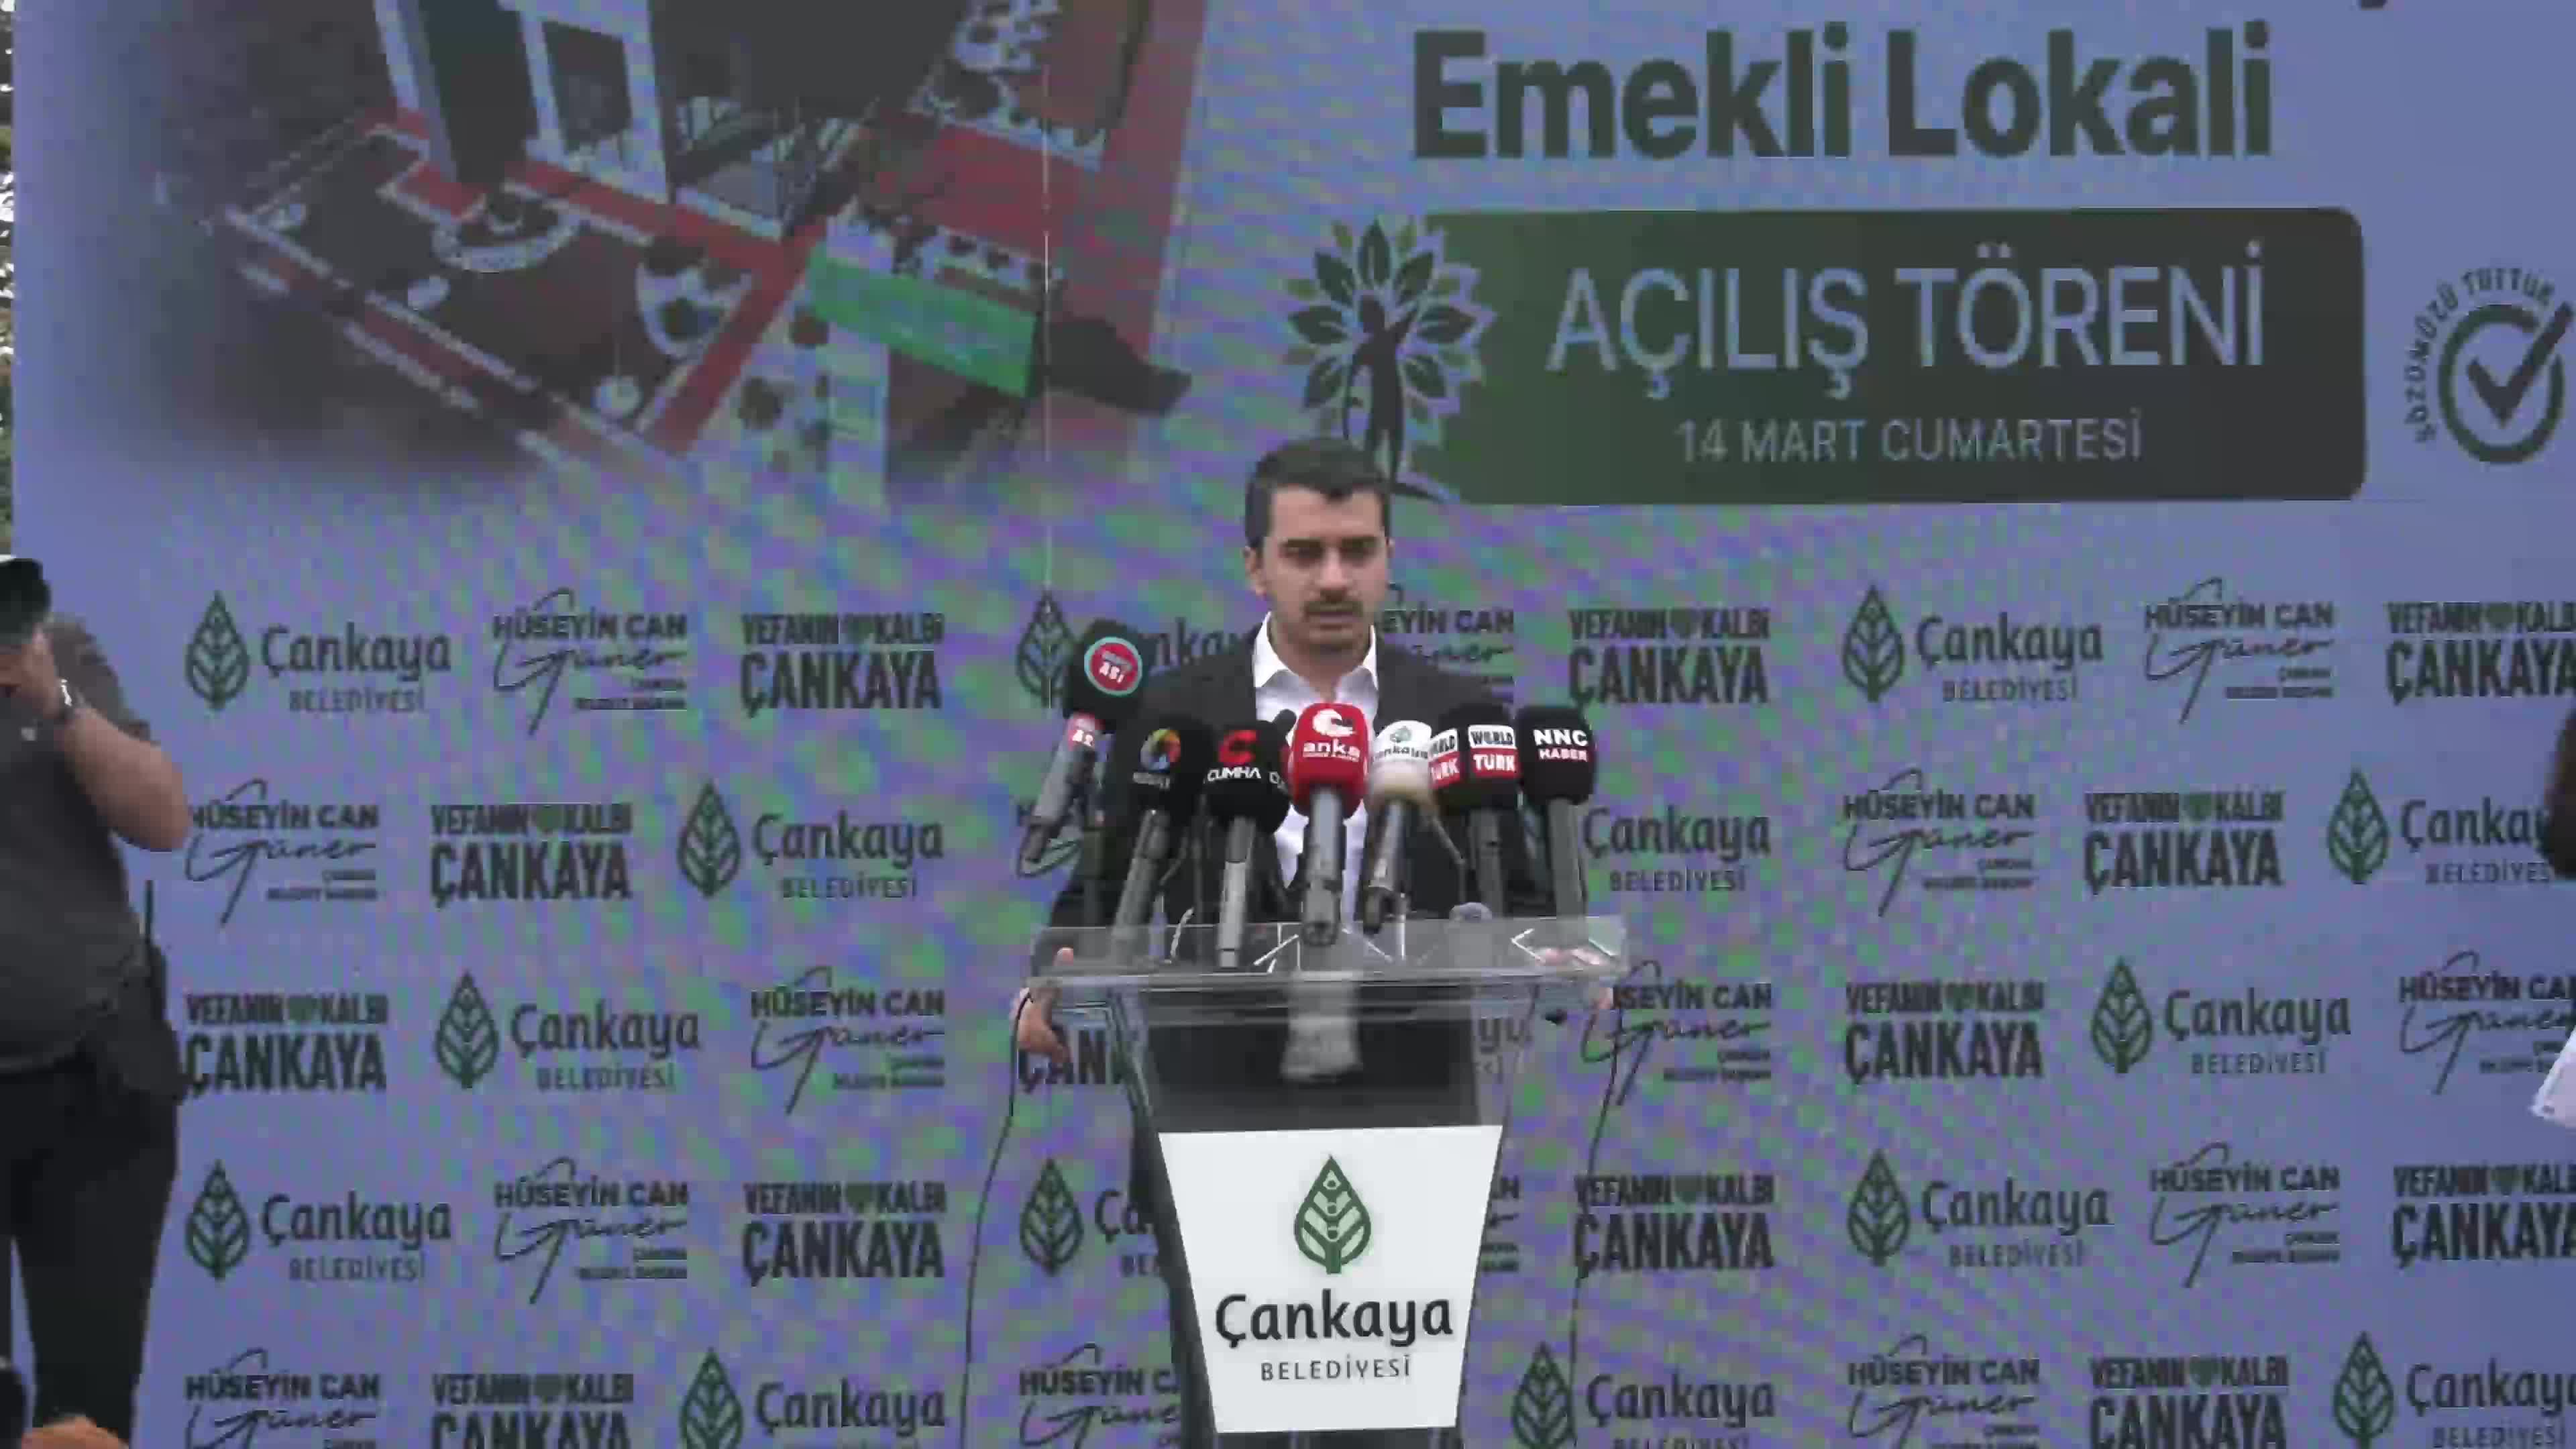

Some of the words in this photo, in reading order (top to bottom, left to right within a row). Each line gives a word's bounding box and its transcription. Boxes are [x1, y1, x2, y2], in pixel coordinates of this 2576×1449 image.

[1415, 21, 1850, 159] Emekli
[1887, 19, 2271, 159] Lokali
[1544, 267, 1869, 399] AÇILIŞ
[1894, 239, 2264, 368] TÖRENİ
[1677, 419, 1728, 463] 14
[1741, 419, 1866, 462] MART
[1882, 407, 2141, 462] CUMARTESİ
[493, 607, 617, 639] HÜSEYİN
[625, 614, 686, 639] CAN
[1382, 602, 1448, 634] EYİN
[1454, 609, 1514, 634] CAN
[1916, 612, 2102, 671] Çankaya
[2146, 597, 2265, 629] HÜSEYİN
[2275, 602, 2332, 629] CAN
[2517, 602, 2576, 634] KALB
[262, 622, 451, 682] Çankaya
[1568, 646, 1768, 708] ÇANKAYA
[741, 651, 943, 718] ÇANKAYA
[1303, 739, 1360, 759] anka
[1533, 729, 1588, 747] NNC
[1540, 747, 1587, 762] HABER
[319, 807, 378, 829] CAN
[1584, 804, 1771, 862] Çankaya
[1844, 789, 1965, 820] HÜSEYİN
[1976, 794, 2034, 820] CAN
[2402, 796, 2555, 853] Çanka
[753, 810, 943, 869] Çankaya
[2086, 829, 2282, 895] ÇANKAYA
[431, 840, 632, 908] ÇANKAYA
[751, 986, 875, 1018] HÜSEYİN
[883, 991, 945, 1016] CAN
[1612, 979, 1703, 1009] SEYİN
[1713, 983, 1772, 1009] CAN
[2400, 969, 2520, 1002] HÜSEYİN
[510, 1000, 699, 1059] Çankaya
[2163, 987, 2351, 1046] Çankaya
[186, 1033, 387, 1095] ÇANKAYA
[1845, 1022, 2044, 1085] ÇANKAYA
[494, 1175, 619, 1207] HÜSEYİN
[627, 1183, 688, 1206] CAN
[2151, 1161, 2270, 1192] HÜSEYİN
[2280, 1167, 2340, 1191] CAN
[2523, 1165, 2576, 1195] KAL
[262, 1191, 451, 1250] Çankaya
[1922, 1177, 2114, 1236] Çankaya
[743, 1220, 945, 1287] ÇANKAYA
[1574, 1212, 1774, 1278] ÇANKAYA
[1215, 1289, 1453, 1348] Çankaya
[185, 1371, 311, 1401] HÜSEYİN
[319, 1374, 380, 1400] CAN
[1019, 1363, 1143, 1395] HÜSEYİN
[1260, 1353, 1410, 1382] BELEDİYESİ
[1849, 1353, 1970, 1385] HÜSEYİN
[1978, 1358, 2039, 1385] CAN
[2406, 1359, 2576, 1415] Çankay
[755, 1377, 946, 1437] Çankaya
[1587, 1370, 1775, 1428] Çankaya
